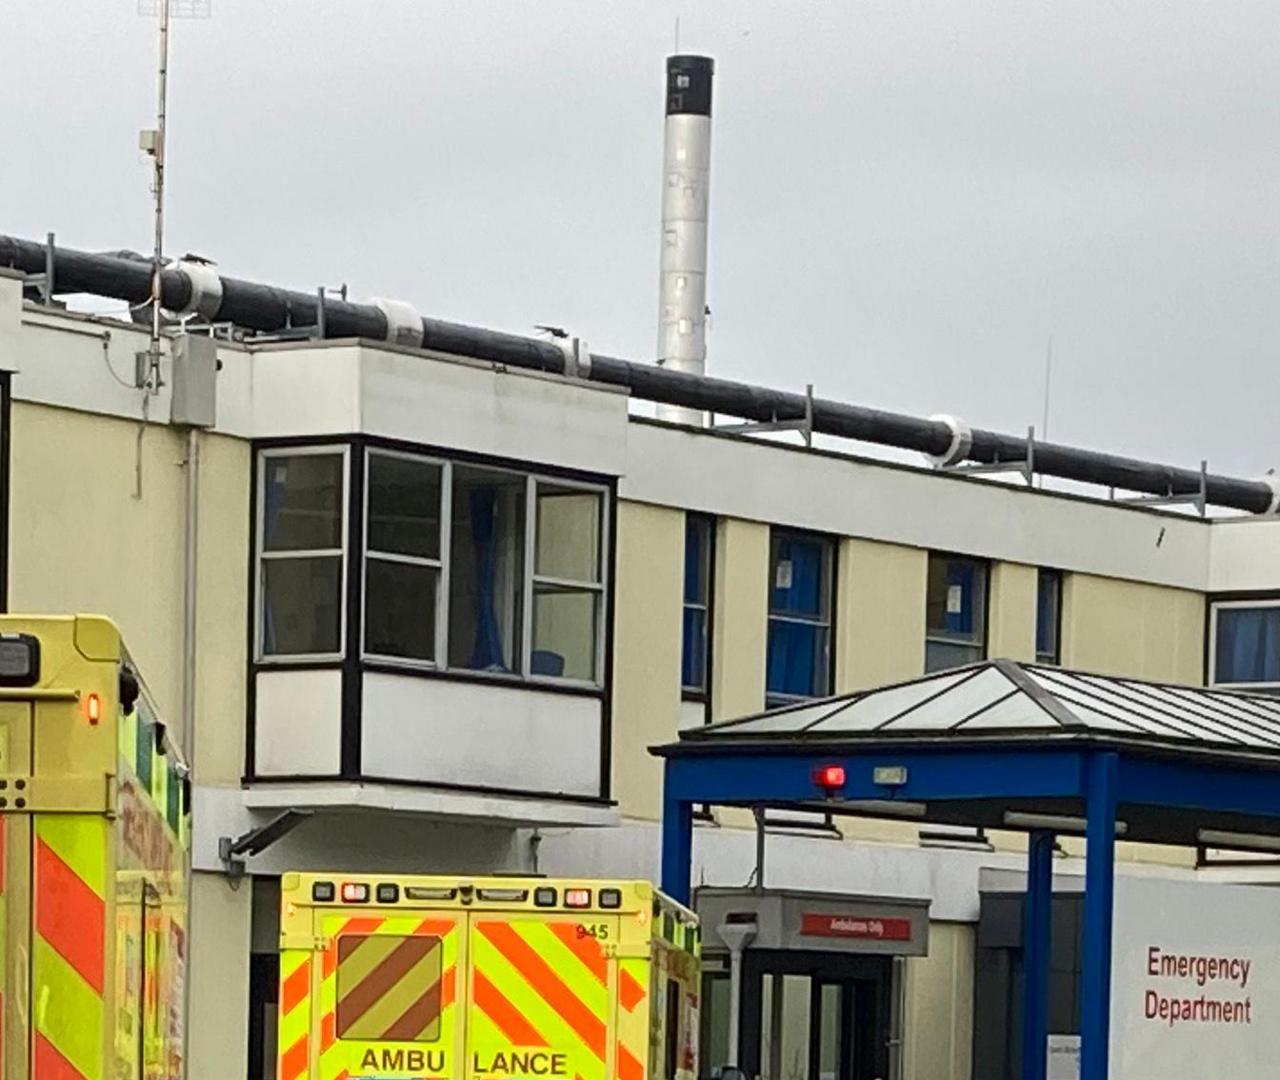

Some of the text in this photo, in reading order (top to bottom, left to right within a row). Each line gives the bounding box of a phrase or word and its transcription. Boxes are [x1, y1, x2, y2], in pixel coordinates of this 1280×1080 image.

[576, 924, 608, 940] 945
[1148, 946, 1251, 988] Emergency
[1145, 990, 1251, 1027] Department
[360, 1049, 567, 1075] AMBU LANCE
